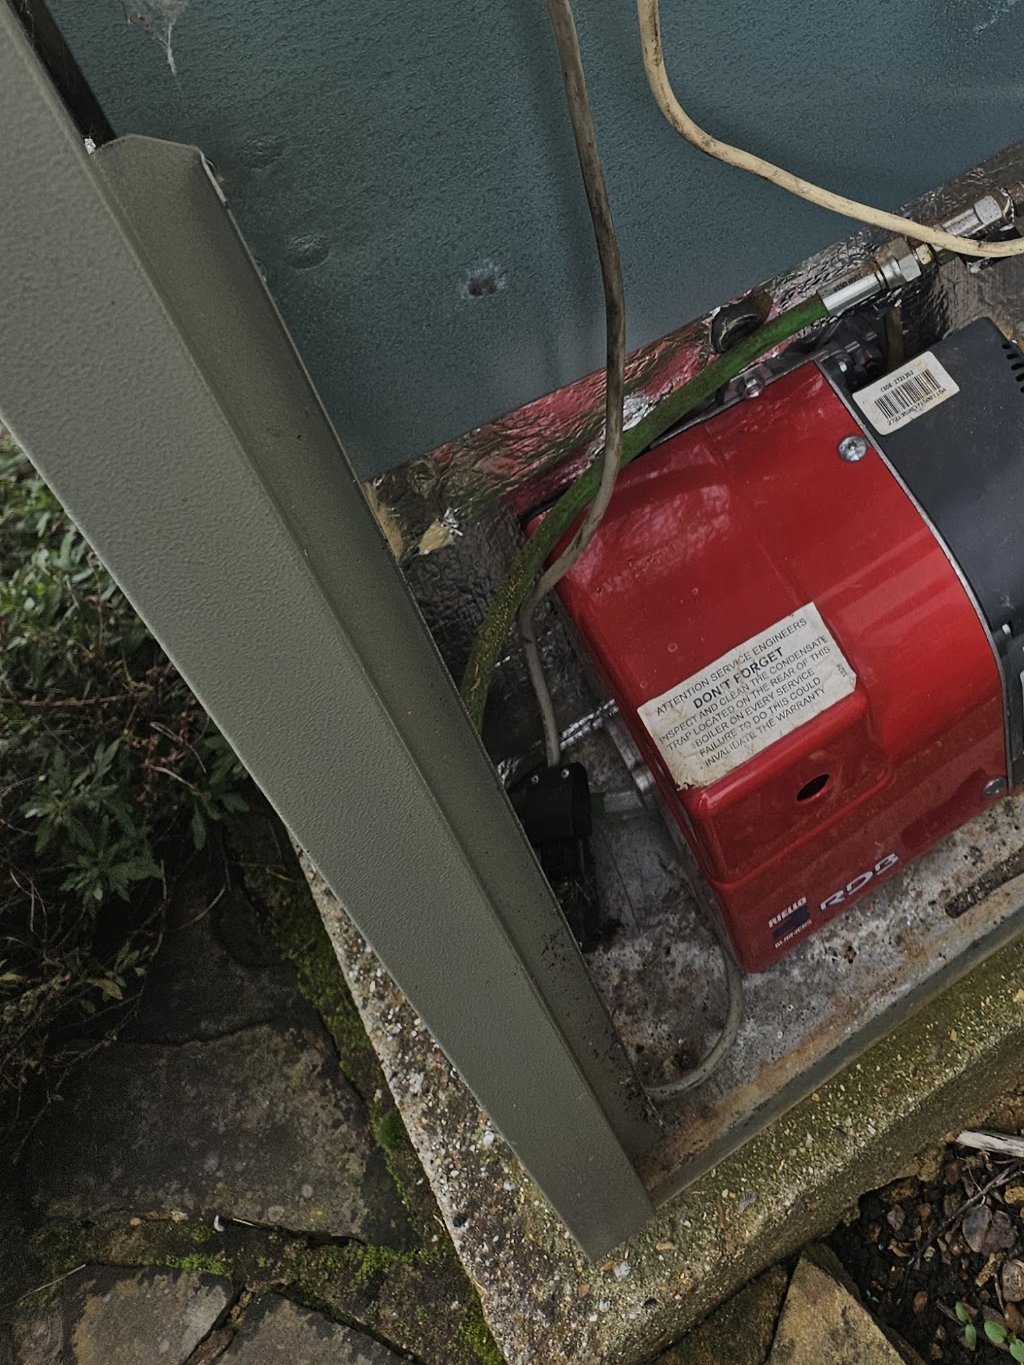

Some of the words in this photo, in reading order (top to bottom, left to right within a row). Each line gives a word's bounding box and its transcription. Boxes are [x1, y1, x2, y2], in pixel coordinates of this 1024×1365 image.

[656, 678, 710, 716] ATTENTION
[709, 651, 751, 682] SERVICE
[752, 617, 808, 655] ENGINEERS
[659, 715, 698, 745] INSPECT
[699, 703, 718, 719] AND
[720, 686, 750, 709] CLEAN
[749, 672, 769, 688] THE
[769, 634, 829, 675] CONDENSATE
[667, 731, 691, 752] TRAP
[693, 706, 735, 736] LOCATED
[736, 695, 751, 709] ON
[750, 685, 770, 700] THE
[769, 667, 795, 687] REAR
[796, 658, 810, 671] OF
[809, 645, 831, 661] THIS
[693, 679, 731, 710] DON'T
[733, 646, 783, 683] FORGET
[695, 722, 729, 748] BOILER
[729, 712, 744, 725] ON
[745, 694, 775, 716] EVERY
[776, 667, 816, 695] SERVICE
[699, 729, 738, 757] FAILURE
[739, 720, 751, 731] TO
[752, 710, 768, 724] DO
[768, 697, 790, 714] THIS
[789, 676, 822, 700] COULD
[704, 732, 757, 768] INVALIDATE
[757, 718, 776, 734] THE
[776, 685, 827, 721] WARRANTY
[768, 896, 807, 928] RIELLO
[820, 853, 899, 911] RDB
